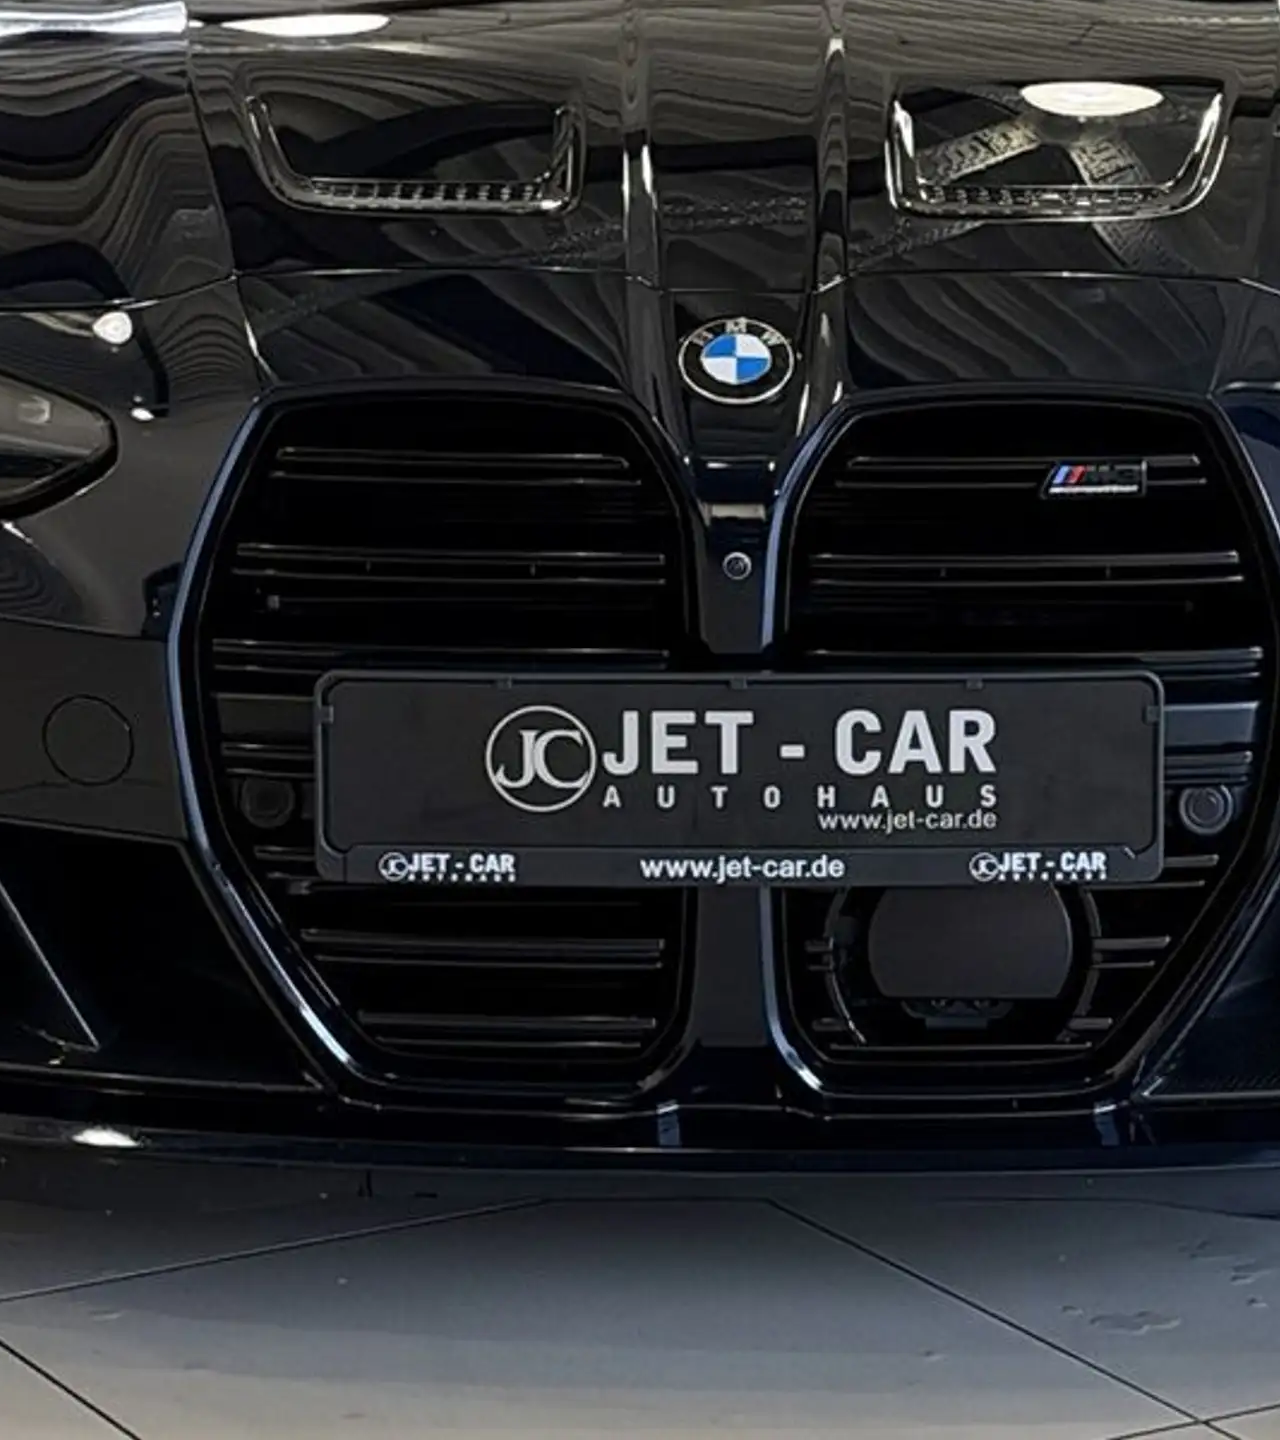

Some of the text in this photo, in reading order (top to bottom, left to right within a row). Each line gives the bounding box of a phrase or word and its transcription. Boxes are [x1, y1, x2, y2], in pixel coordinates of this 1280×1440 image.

[603, 710, 754, 775] JET
[835, 709, 996, 775] CAR
[603, 785, 997, 809] AUTOHAUS
[818, 809, 997, 834] www.jet-car.de
[408, 852, 451, 873] JET
[469, 853, 515, 873] CAR
[640, 854, 845, 884] www.jet-car.de
[999, 851, 1042, 872] JET
[1060, 851, 1107, 872] CAR
